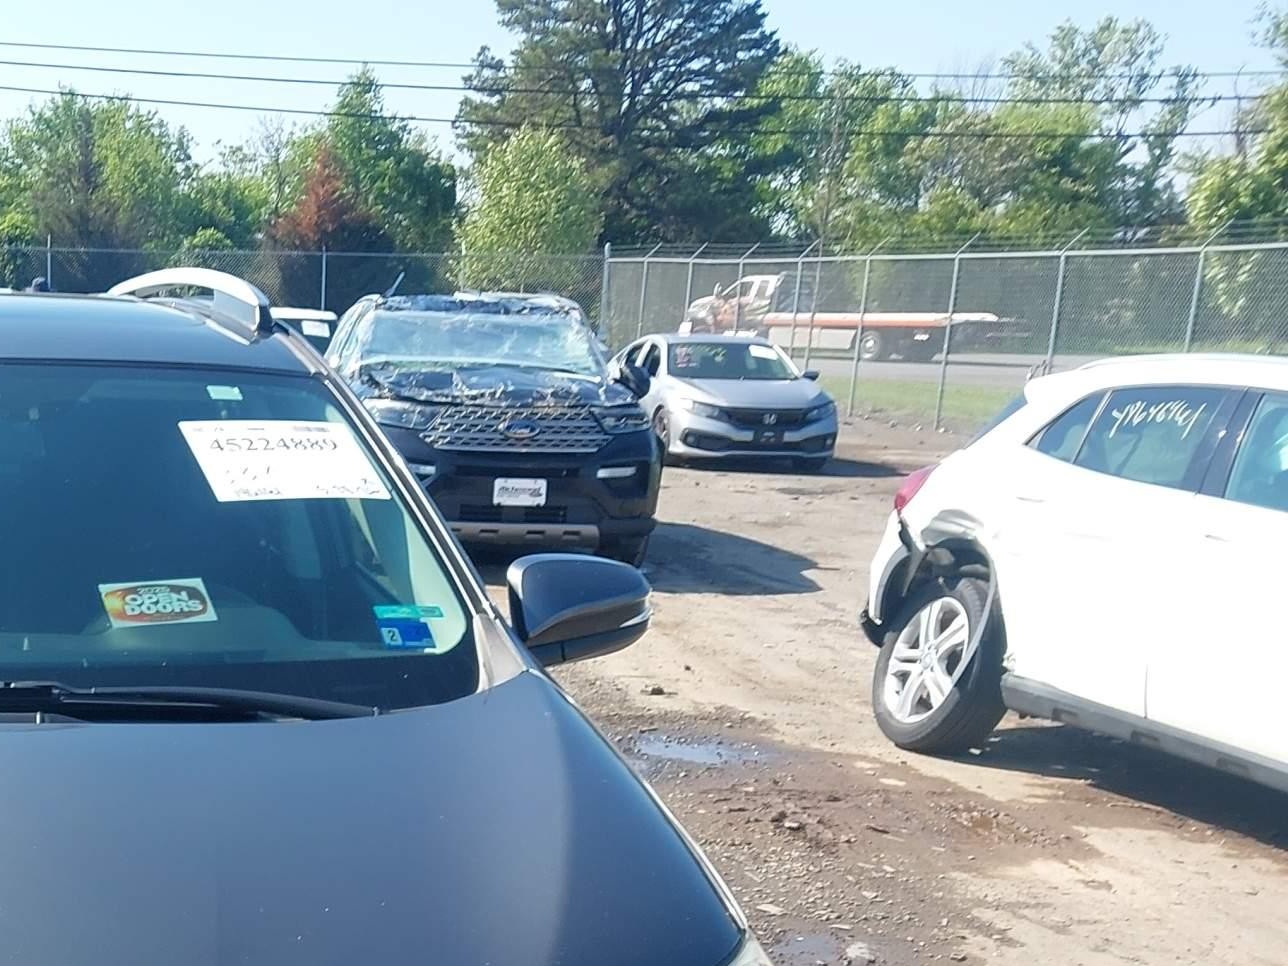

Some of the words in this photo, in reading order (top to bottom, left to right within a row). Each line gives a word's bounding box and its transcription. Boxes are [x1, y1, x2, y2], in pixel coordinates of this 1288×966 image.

[124, 590, 190, 605] OPEN
[124, 599, 204, 615] DOORS
[387, 629, 397, 642] 2
